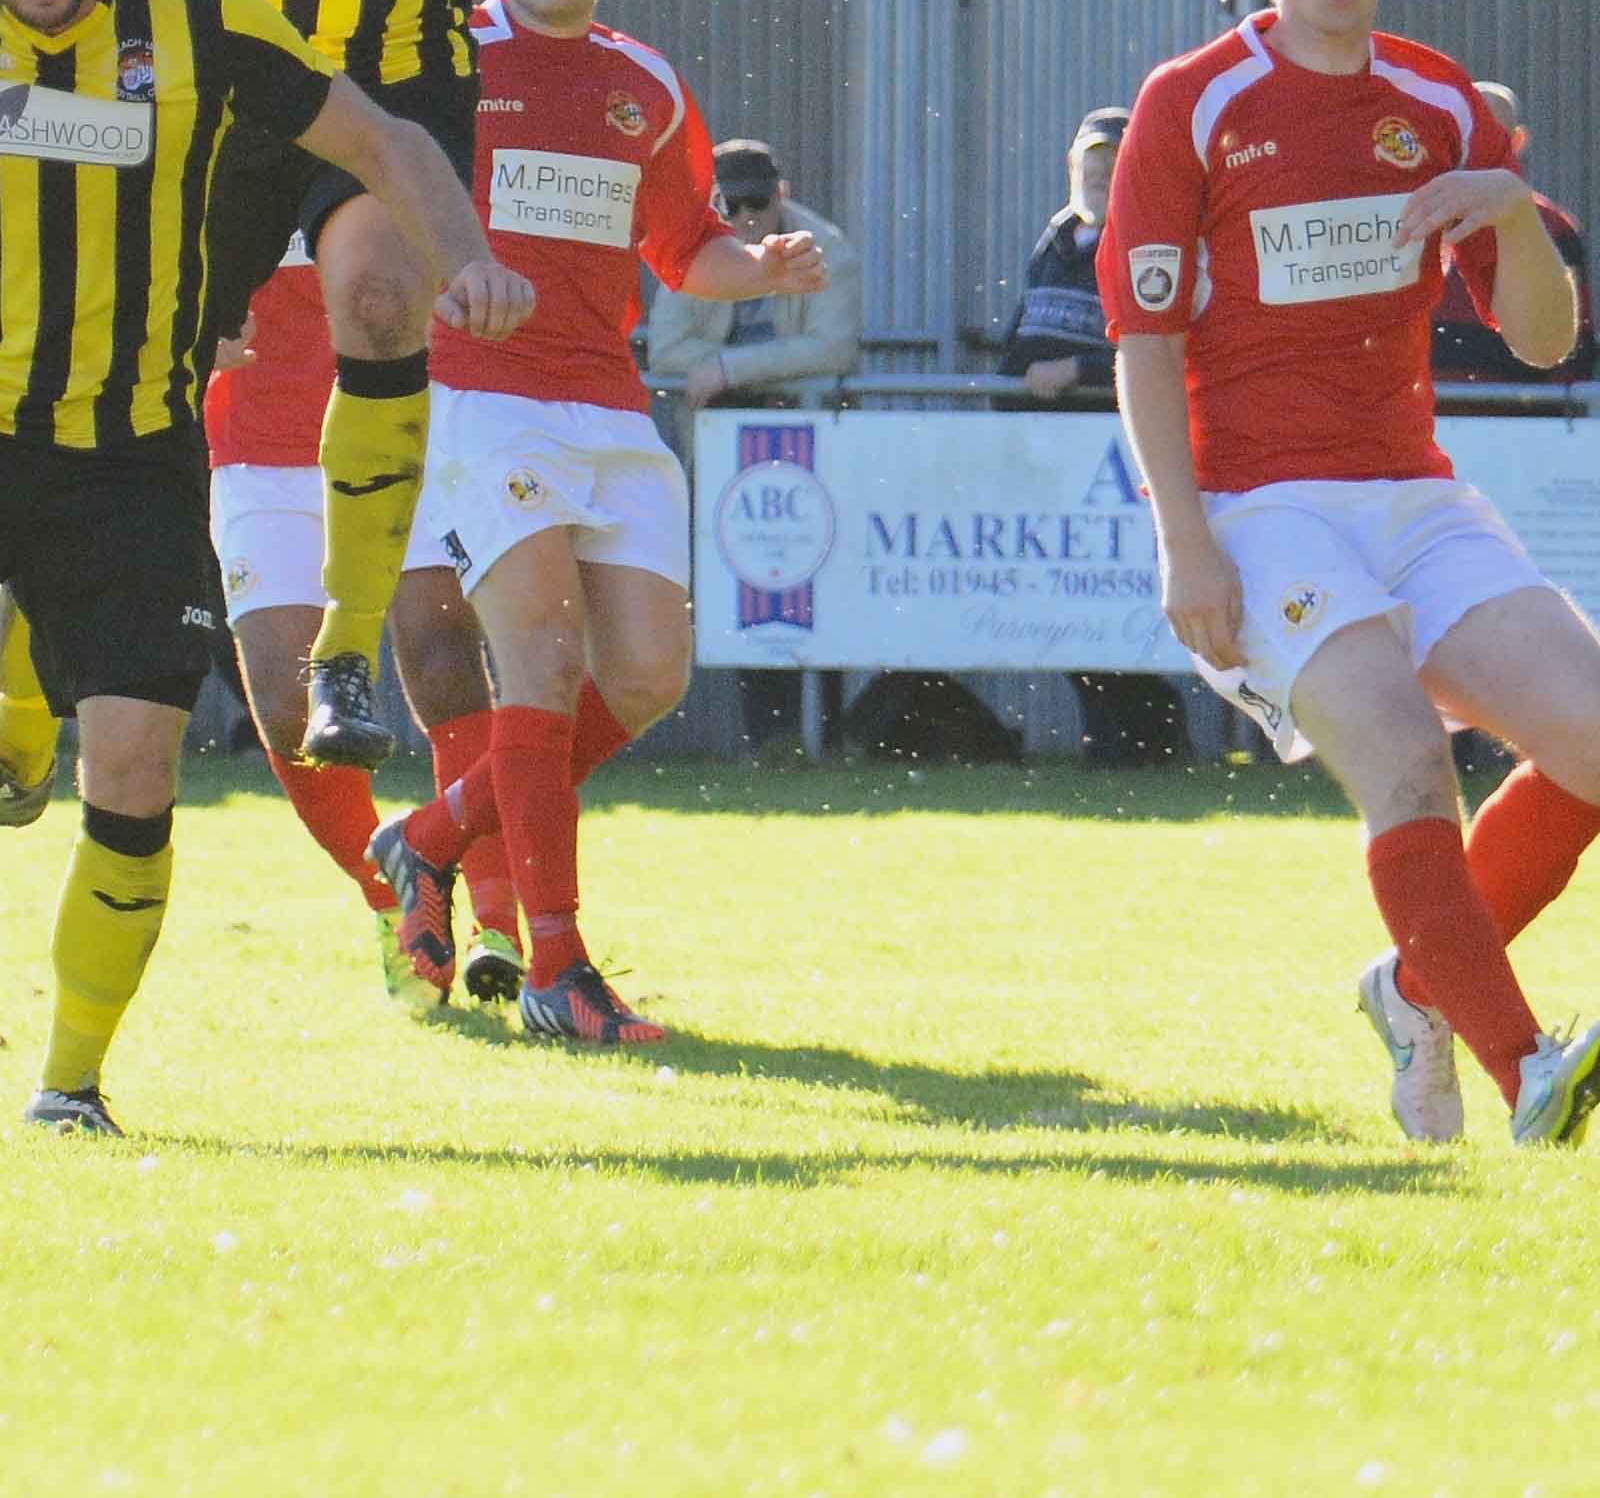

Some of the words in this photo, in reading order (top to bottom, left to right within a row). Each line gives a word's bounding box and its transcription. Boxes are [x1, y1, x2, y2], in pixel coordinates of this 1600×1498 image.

[478, 98, 524, 113] mitre
[1225, 139, 1277, 169] mitre
[497, 163, 633, 204] M.Pinches
[513, 198, 612, 231] Transport
[1260, 213, 1404, 255] M.Pinch
[1283, 254, 1403, 286] Transport
[731, 484, 810, 522] ABC
[864, 511, 1134, 563] MARKET
[864, 565, 919, 597] Tel:
[927, 566, 1020, 598] 01945
